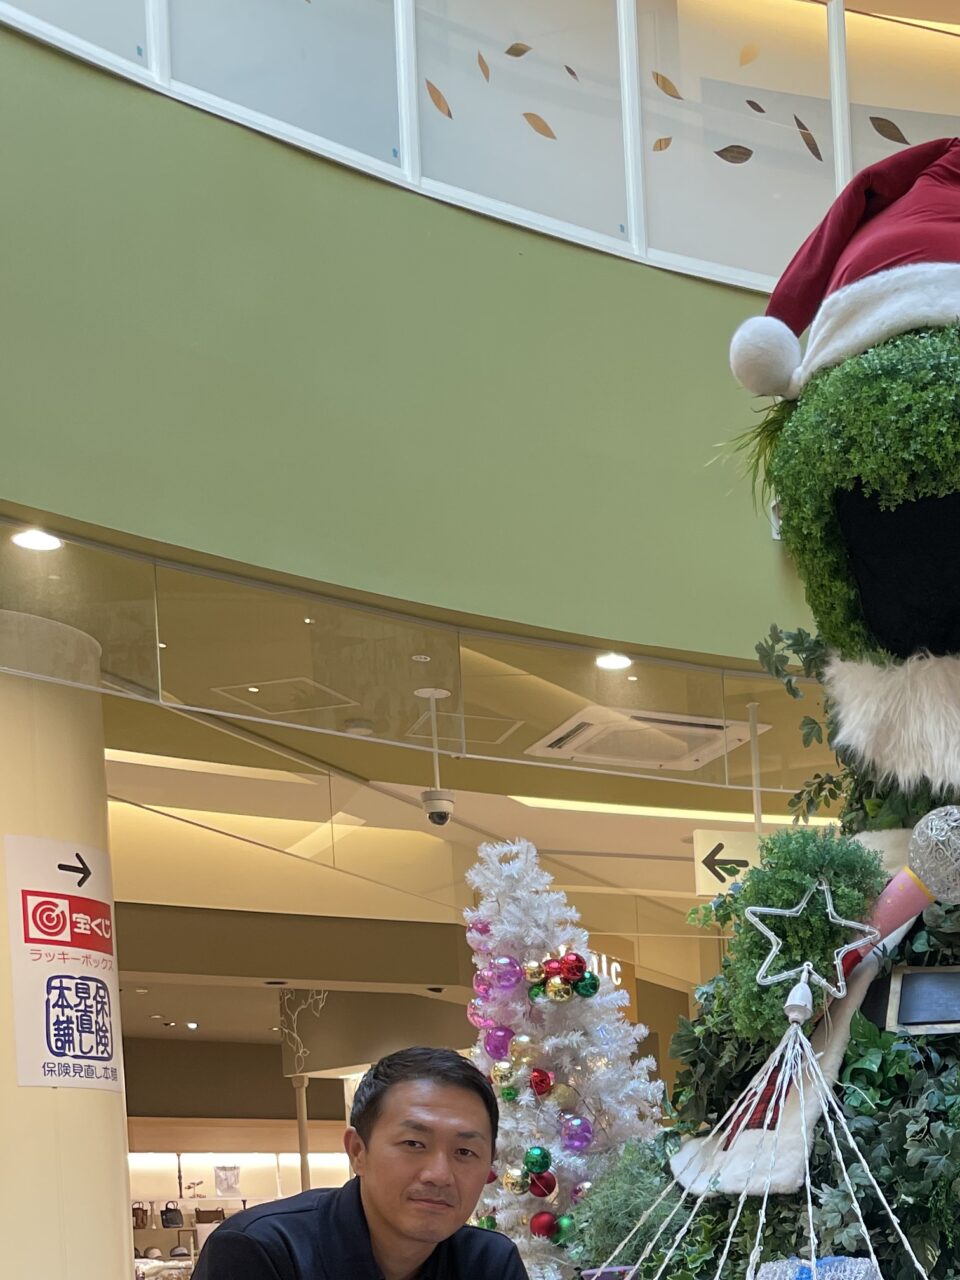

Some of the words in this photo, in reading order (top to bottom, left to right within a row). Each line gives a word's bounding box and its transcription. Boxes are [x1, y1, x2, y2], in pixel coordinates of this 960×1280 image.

[72, 912, 111, 938] 宝くじ
[30, 949, 114, 971] ラッキーボックス
[74, 982, 94, 1056] 見直し
[42, 1062, 118, 1081] 保険見直し本舗
